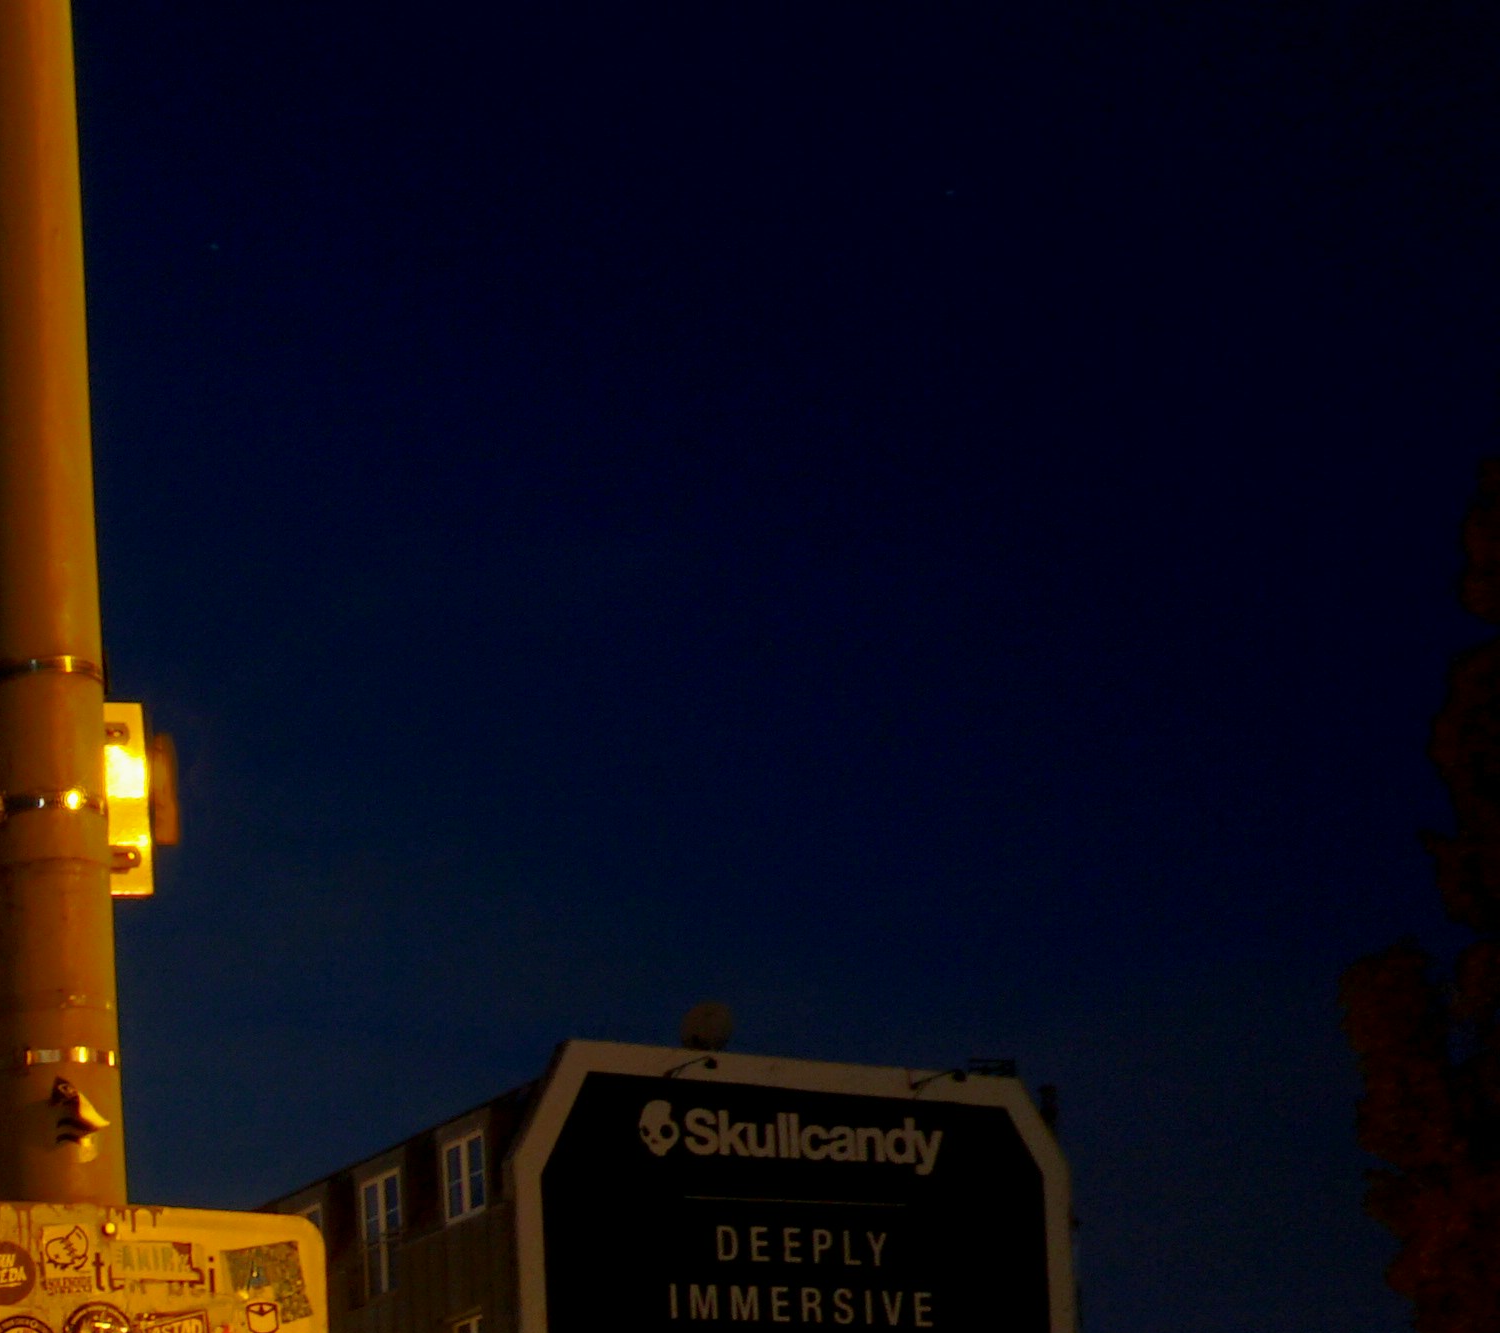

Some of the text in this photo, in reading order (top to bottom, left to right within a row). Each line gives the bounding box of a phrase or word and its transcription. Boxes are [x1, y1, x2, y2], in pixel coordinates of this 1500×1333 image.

[684, 1107, 944, 1175] Skullcandy
[714, 1224, 890, 1267] DEEPLY
[667, 1283, 935, 1329] IMMERSIVE
